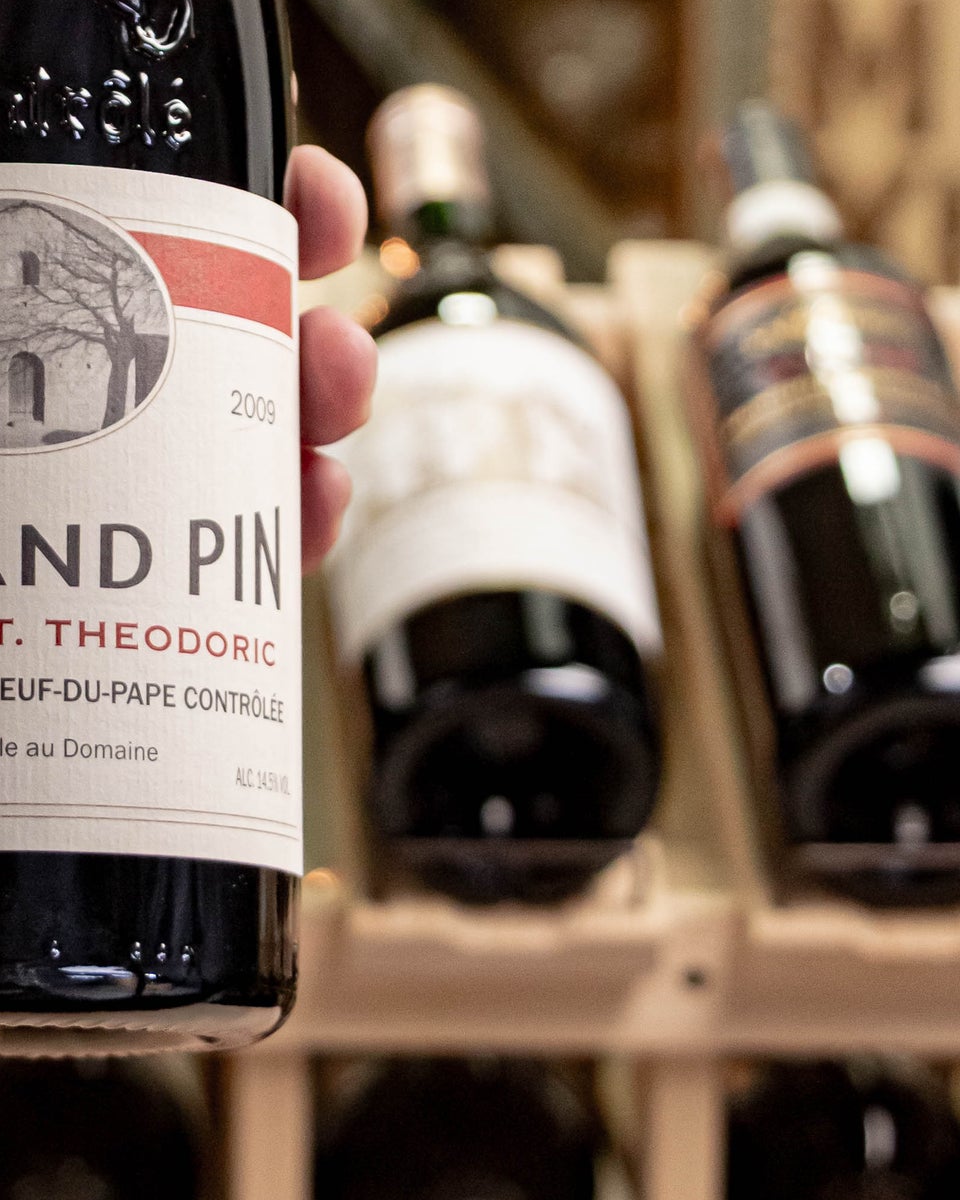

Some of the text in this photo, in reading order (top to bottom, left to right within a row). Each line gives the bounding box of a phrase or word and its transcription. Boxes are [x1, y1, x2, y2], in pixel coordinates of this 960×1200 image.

[231, 389, 276, 425] 2009
[188, 505, 281, 611] PIN
[44, 618, 277, 667] THEODORIC
[183, 685, 284, 723] CONTRÔLÉE
[25, 741, 54, 758] au
[63, 737, 159, 762] Domaine
